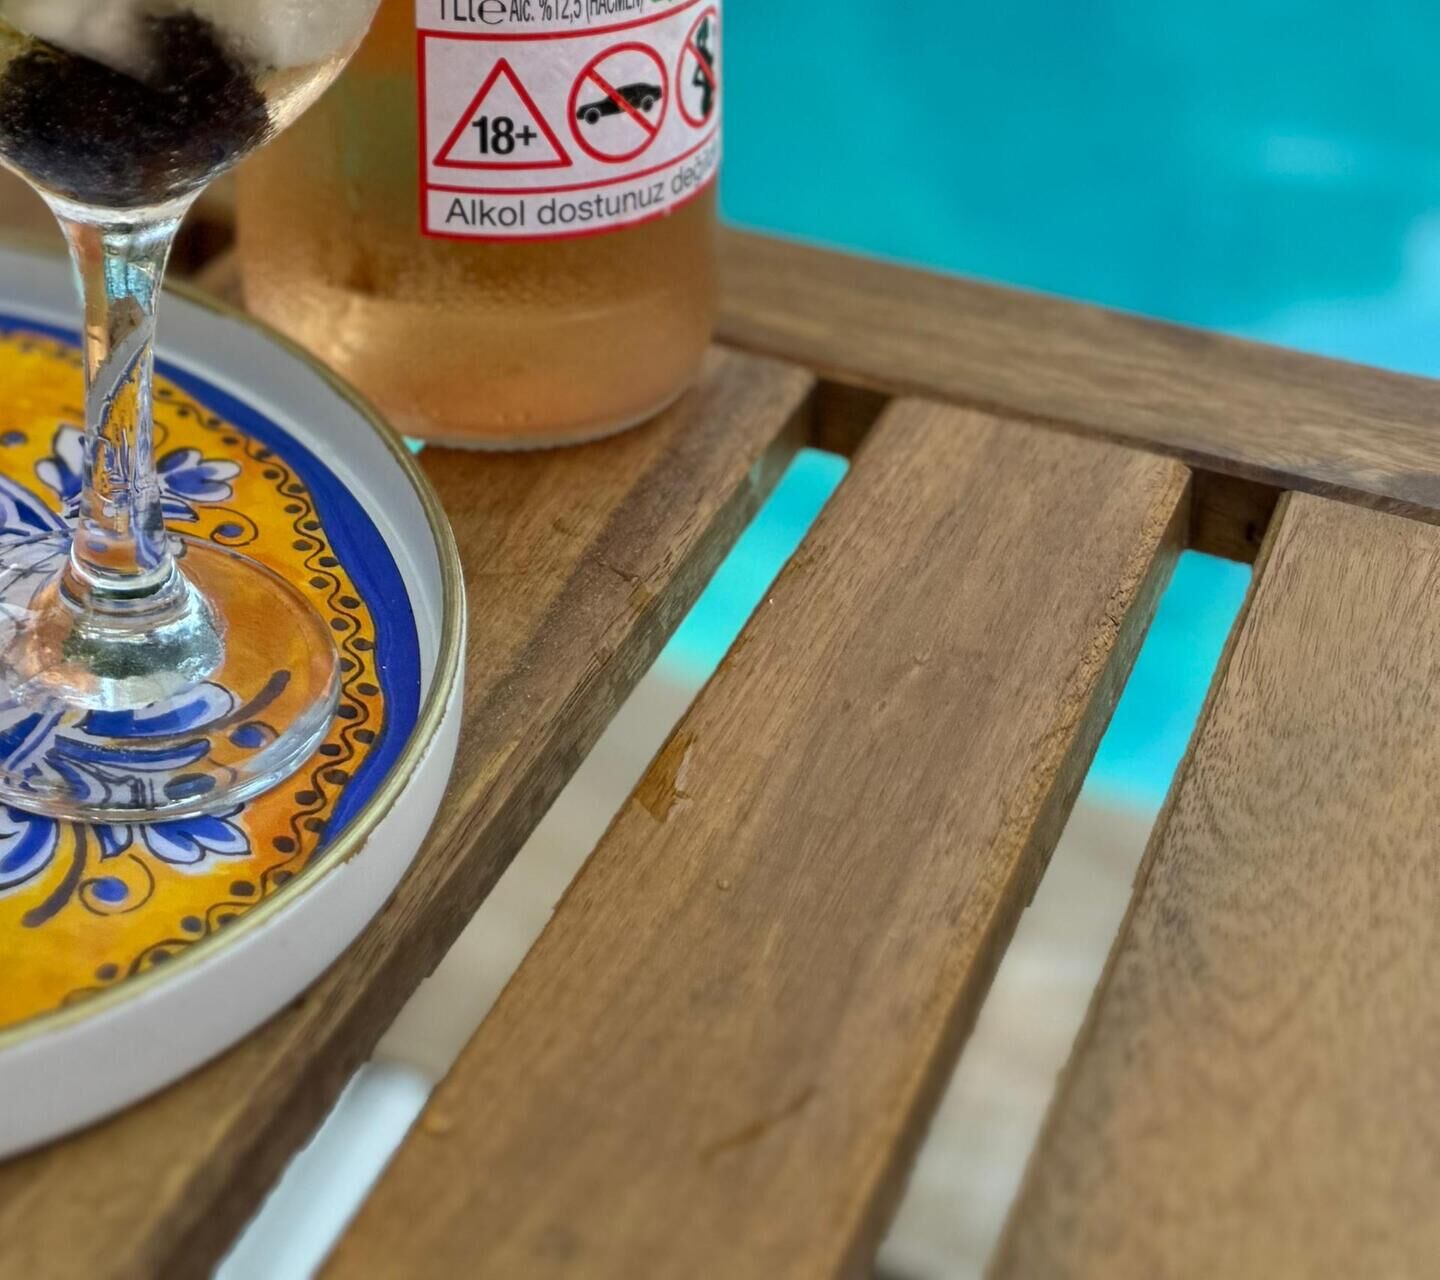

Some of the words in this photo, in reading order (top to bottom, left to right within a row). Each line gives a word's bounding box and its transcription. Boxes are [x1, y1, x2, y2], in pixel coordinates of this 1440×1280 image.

[471, 115, 537, 156] 18+
[445, 197, 525, 227] Alkol
[537, 178, 665, 225] dostunuz
